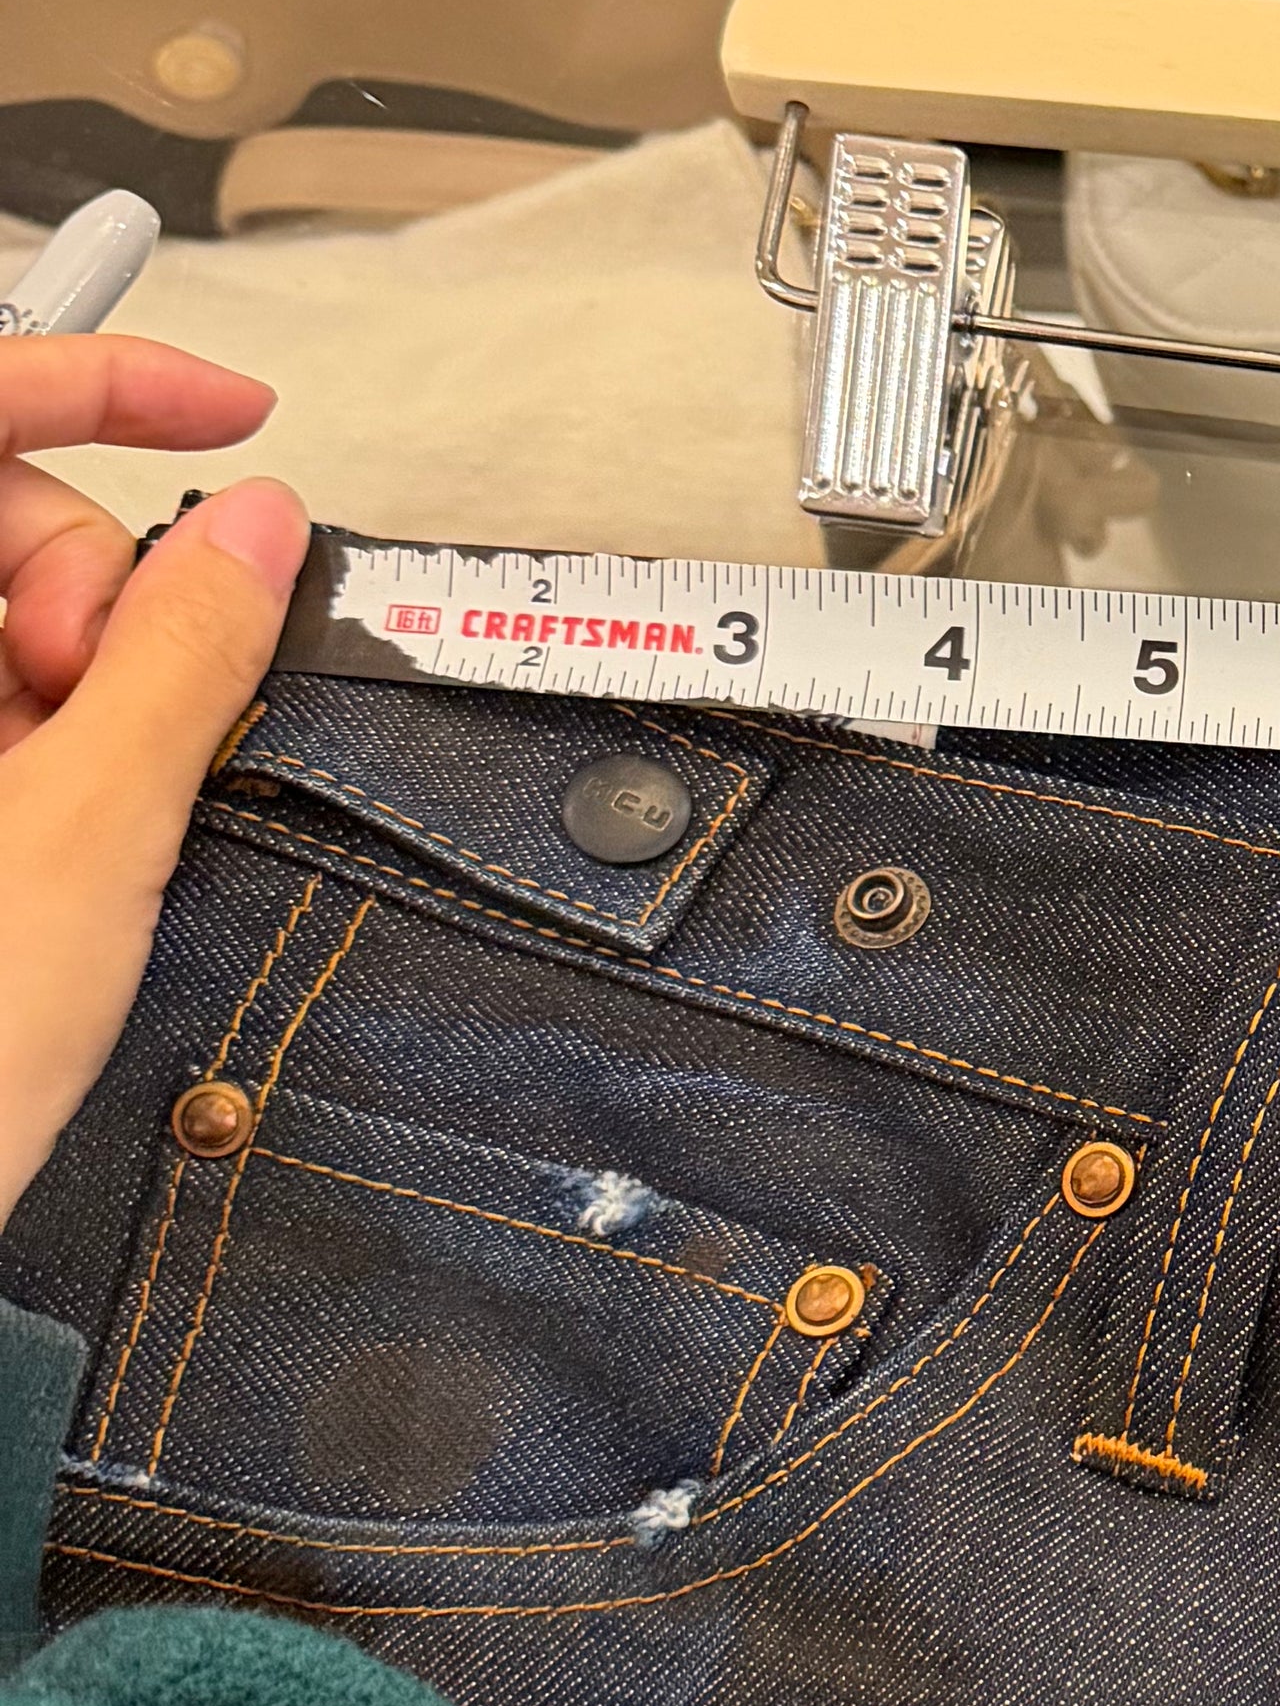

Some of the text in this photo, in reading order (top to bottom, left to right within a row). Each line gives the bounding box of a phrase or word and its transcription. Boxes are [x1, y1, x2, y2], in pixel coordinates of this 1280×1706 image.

[530, 578, 552, 603] 2
[518, 645, 545, 667] 2
[712, 609, 760, 666] 3
[923, 626, 971, 681] 4
[1133, 640, 1181, 695] 5
